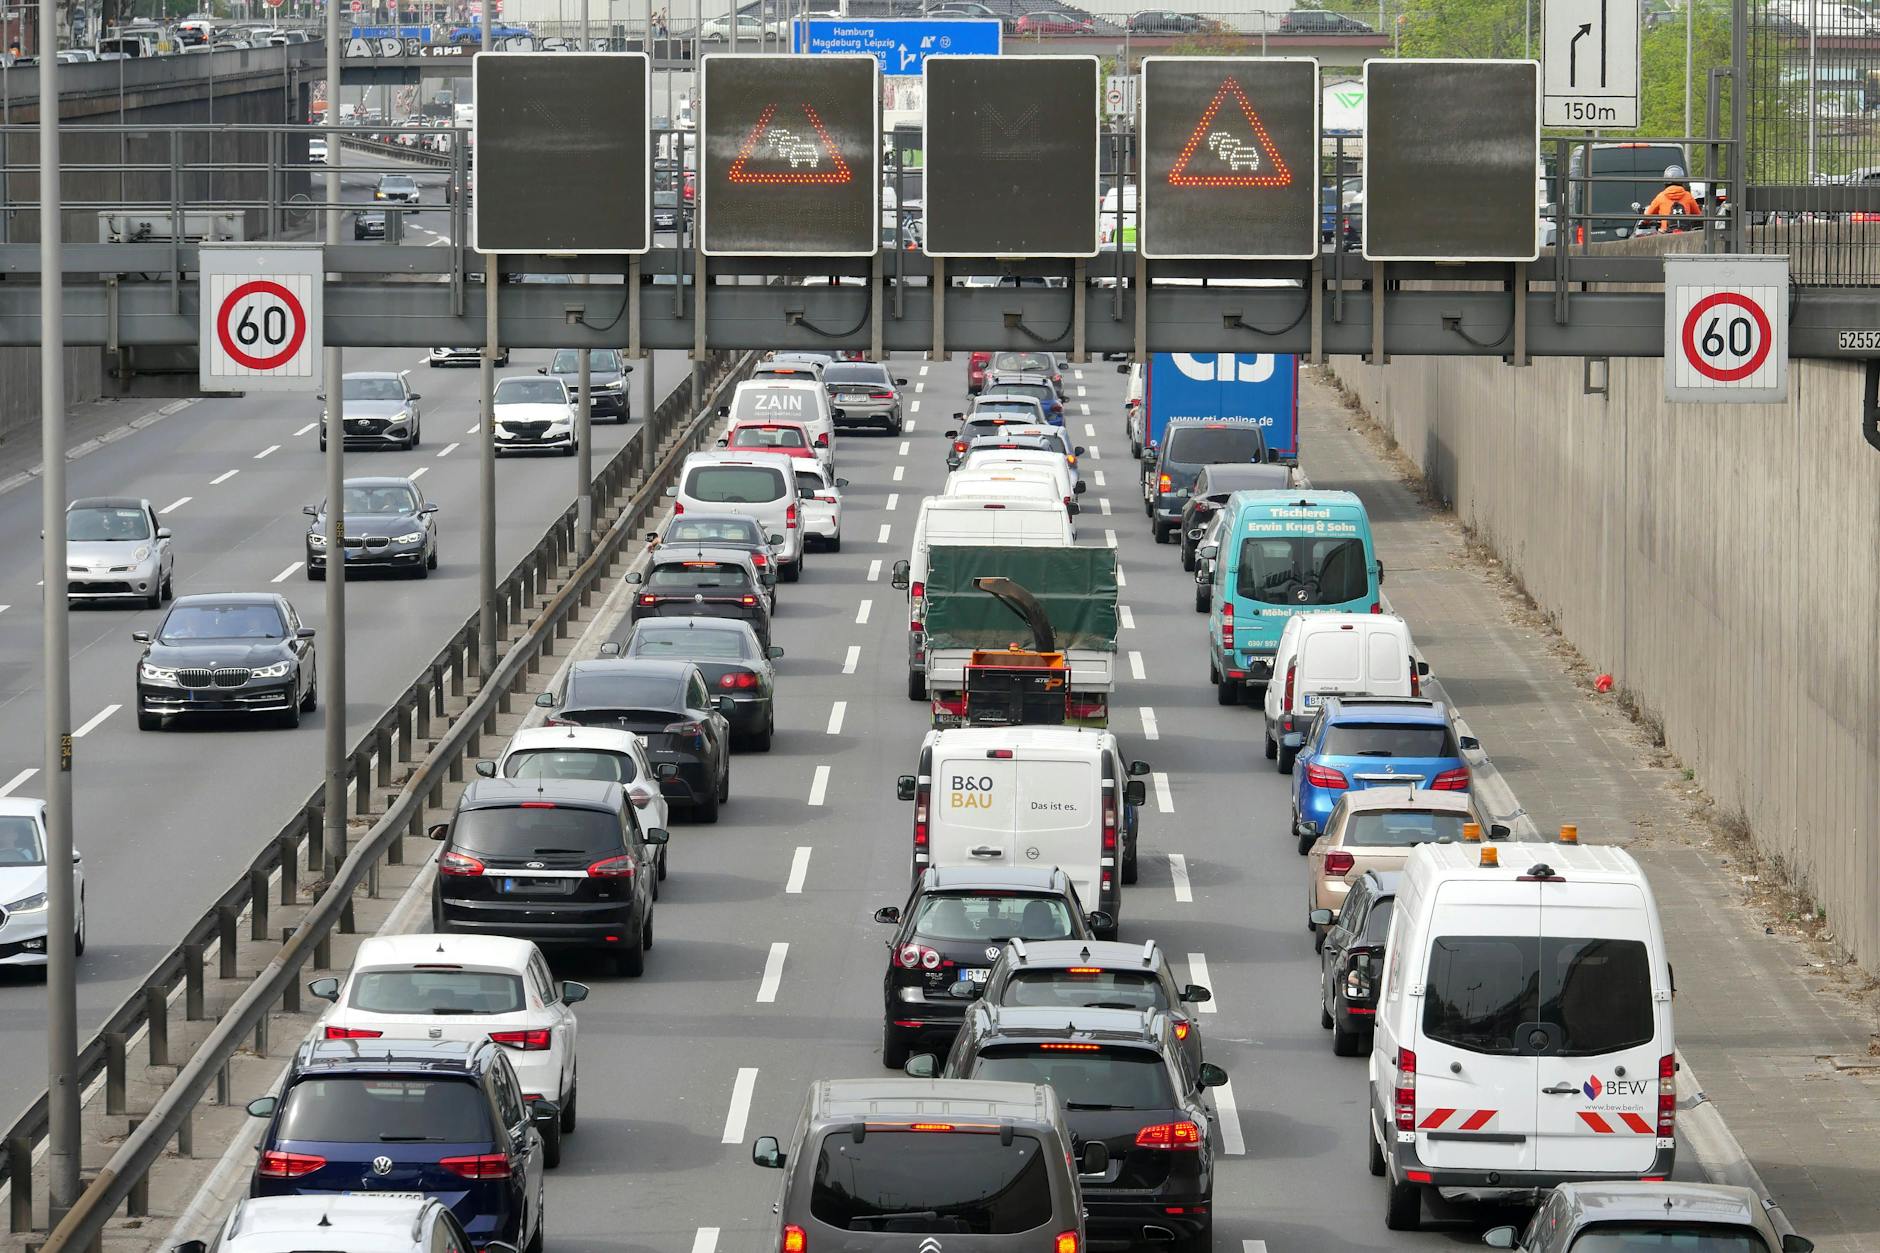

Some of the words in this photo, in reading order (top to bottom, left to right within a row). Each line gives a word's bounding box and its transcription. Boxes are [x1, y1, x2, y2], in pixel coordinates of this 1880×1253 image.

[833, 27, 875, 38] Hamburg
[812, 38, 861, 49] Magdeburg
[864, 38, 895, 48] Leipzig
[1564, 102, 1616, 121] 150m
[237, 305, 286, 346] 60
[1702, 317, 1752, 357] 60
[1840, 332, 1880, 349] 52552
[755, 395, 802, 410] ZAIN
[1270, 508, 1330, 518] Tischlerei
[1248, 522, 1282, 532] Erwin
[1286, 522, 1315, 533] Krug
[1316, 520, 1324, 531] &
[1327, 522, 1356, 532] Sohn
[1262, 608, 1292, 617] Möbel
[952, 776, 993, 791] B&O
[951, 793, 993, 809] BAU
[1031, 801, 1048, 811] Das
[1050, 801, 1062, 811] ist
[1064, 803, 1078, 811] es.
[967, 971, 974, 980] B
[1606, 1080, 1648, 1095] BEW
